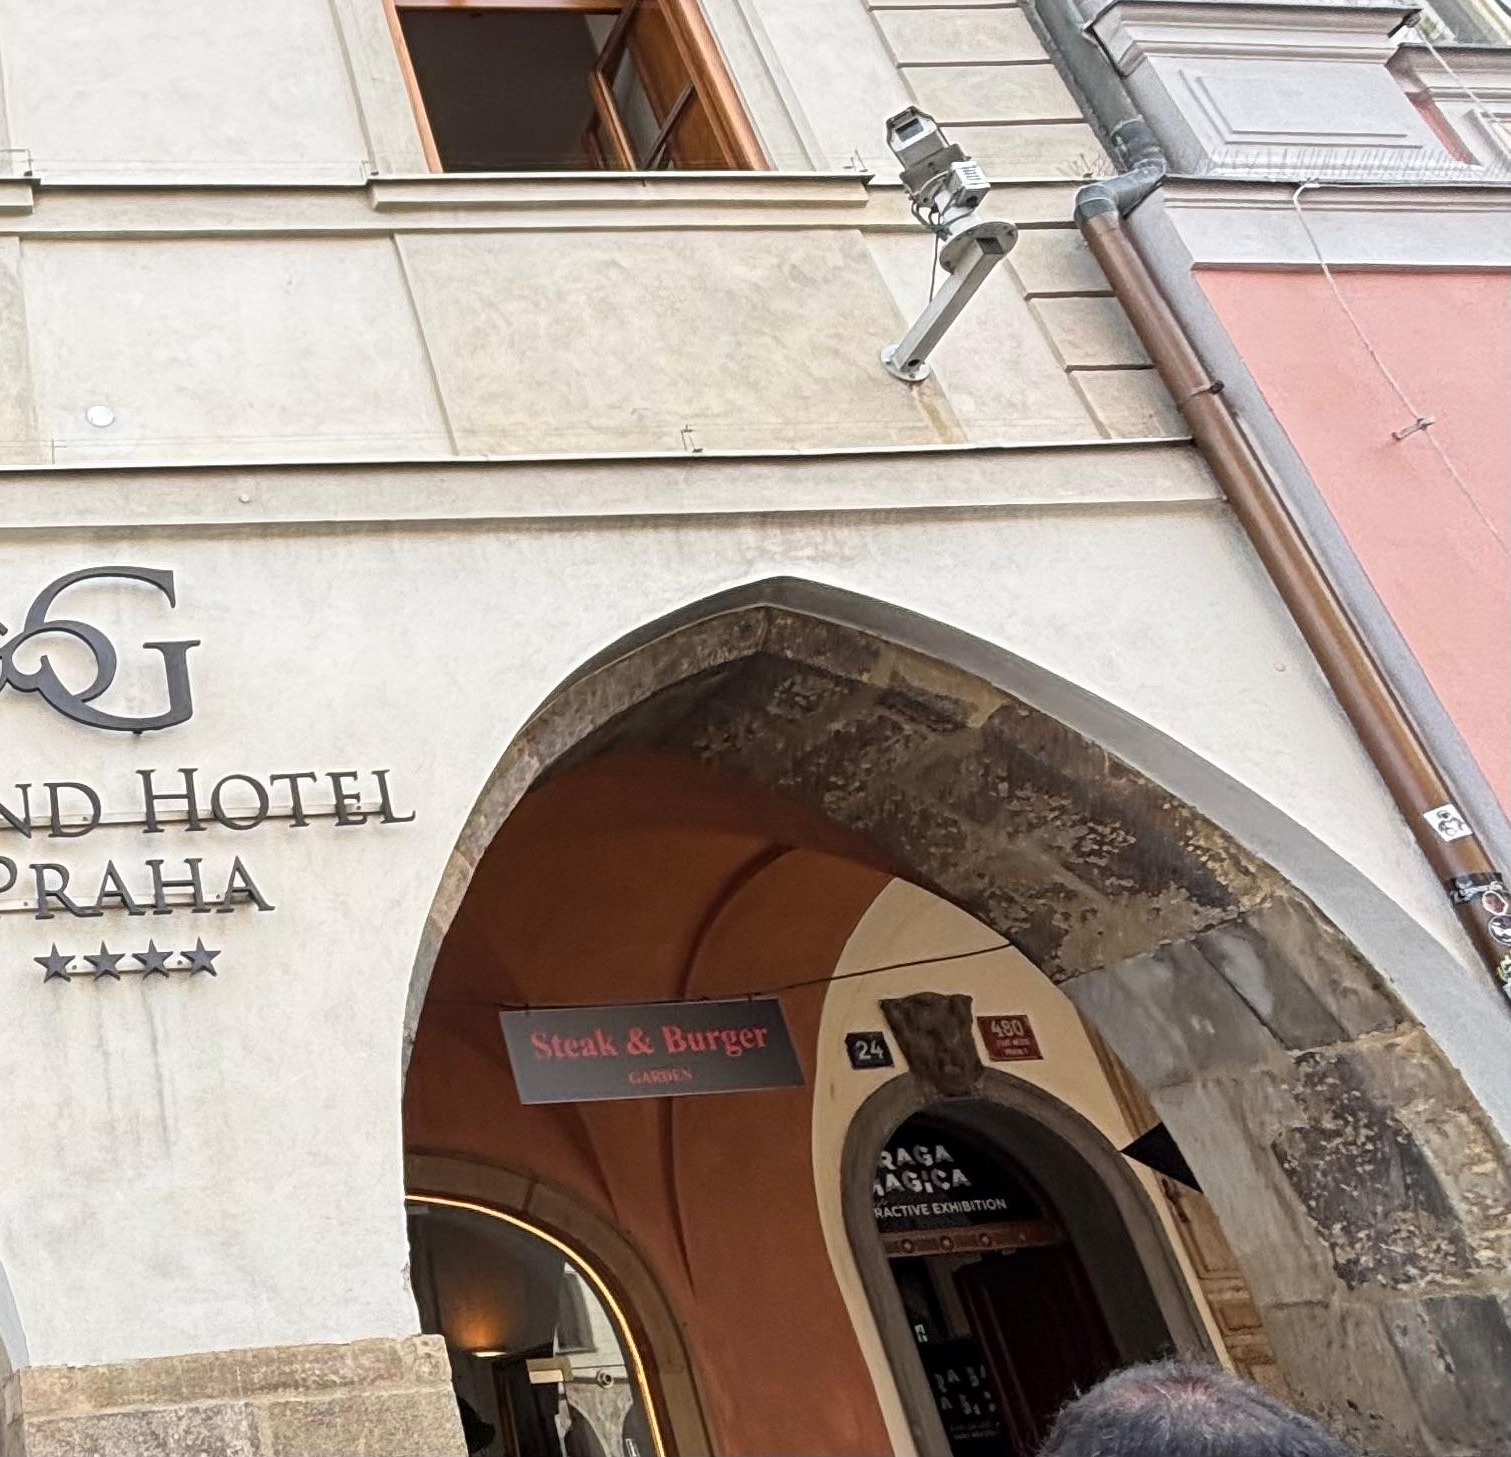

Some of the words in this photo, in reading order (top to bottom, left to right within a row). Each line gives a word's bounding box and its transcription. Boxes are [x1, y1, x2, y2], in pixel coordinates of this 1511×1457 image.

[136, 767, 417, 834] HOTEL
[531, 1027, 619, 1059] Steak
[626, 1026, 655, 1055] &
[662, 1023, 768, 1058] Burger
[990, 1019, 1025, 1038] 480
[854, 1039, 885, 1061] 24
[878, 1143, 954, 1171] RAGA
[874, 1203, 931, 1219] RACTIVE
[932, 1198, 1008, 1216] EXHIBITION
